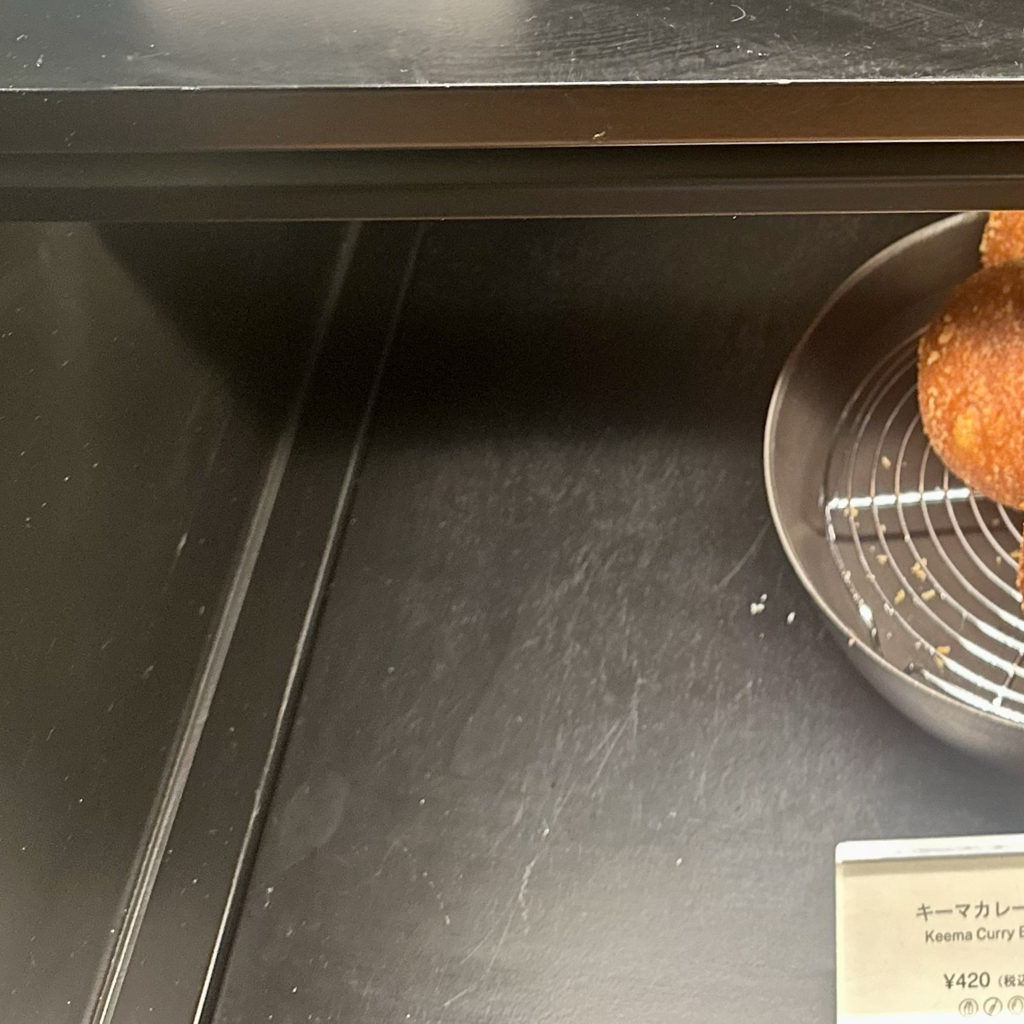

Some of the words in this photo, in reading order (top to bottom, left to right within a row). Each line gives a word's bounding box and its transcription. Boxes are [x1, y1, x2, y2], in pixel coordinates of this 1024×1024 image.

[924, 929, 973, 944] Keema
[976, 926, 1015, 942] Curry
[943, 971, 991, 989] ¥420
